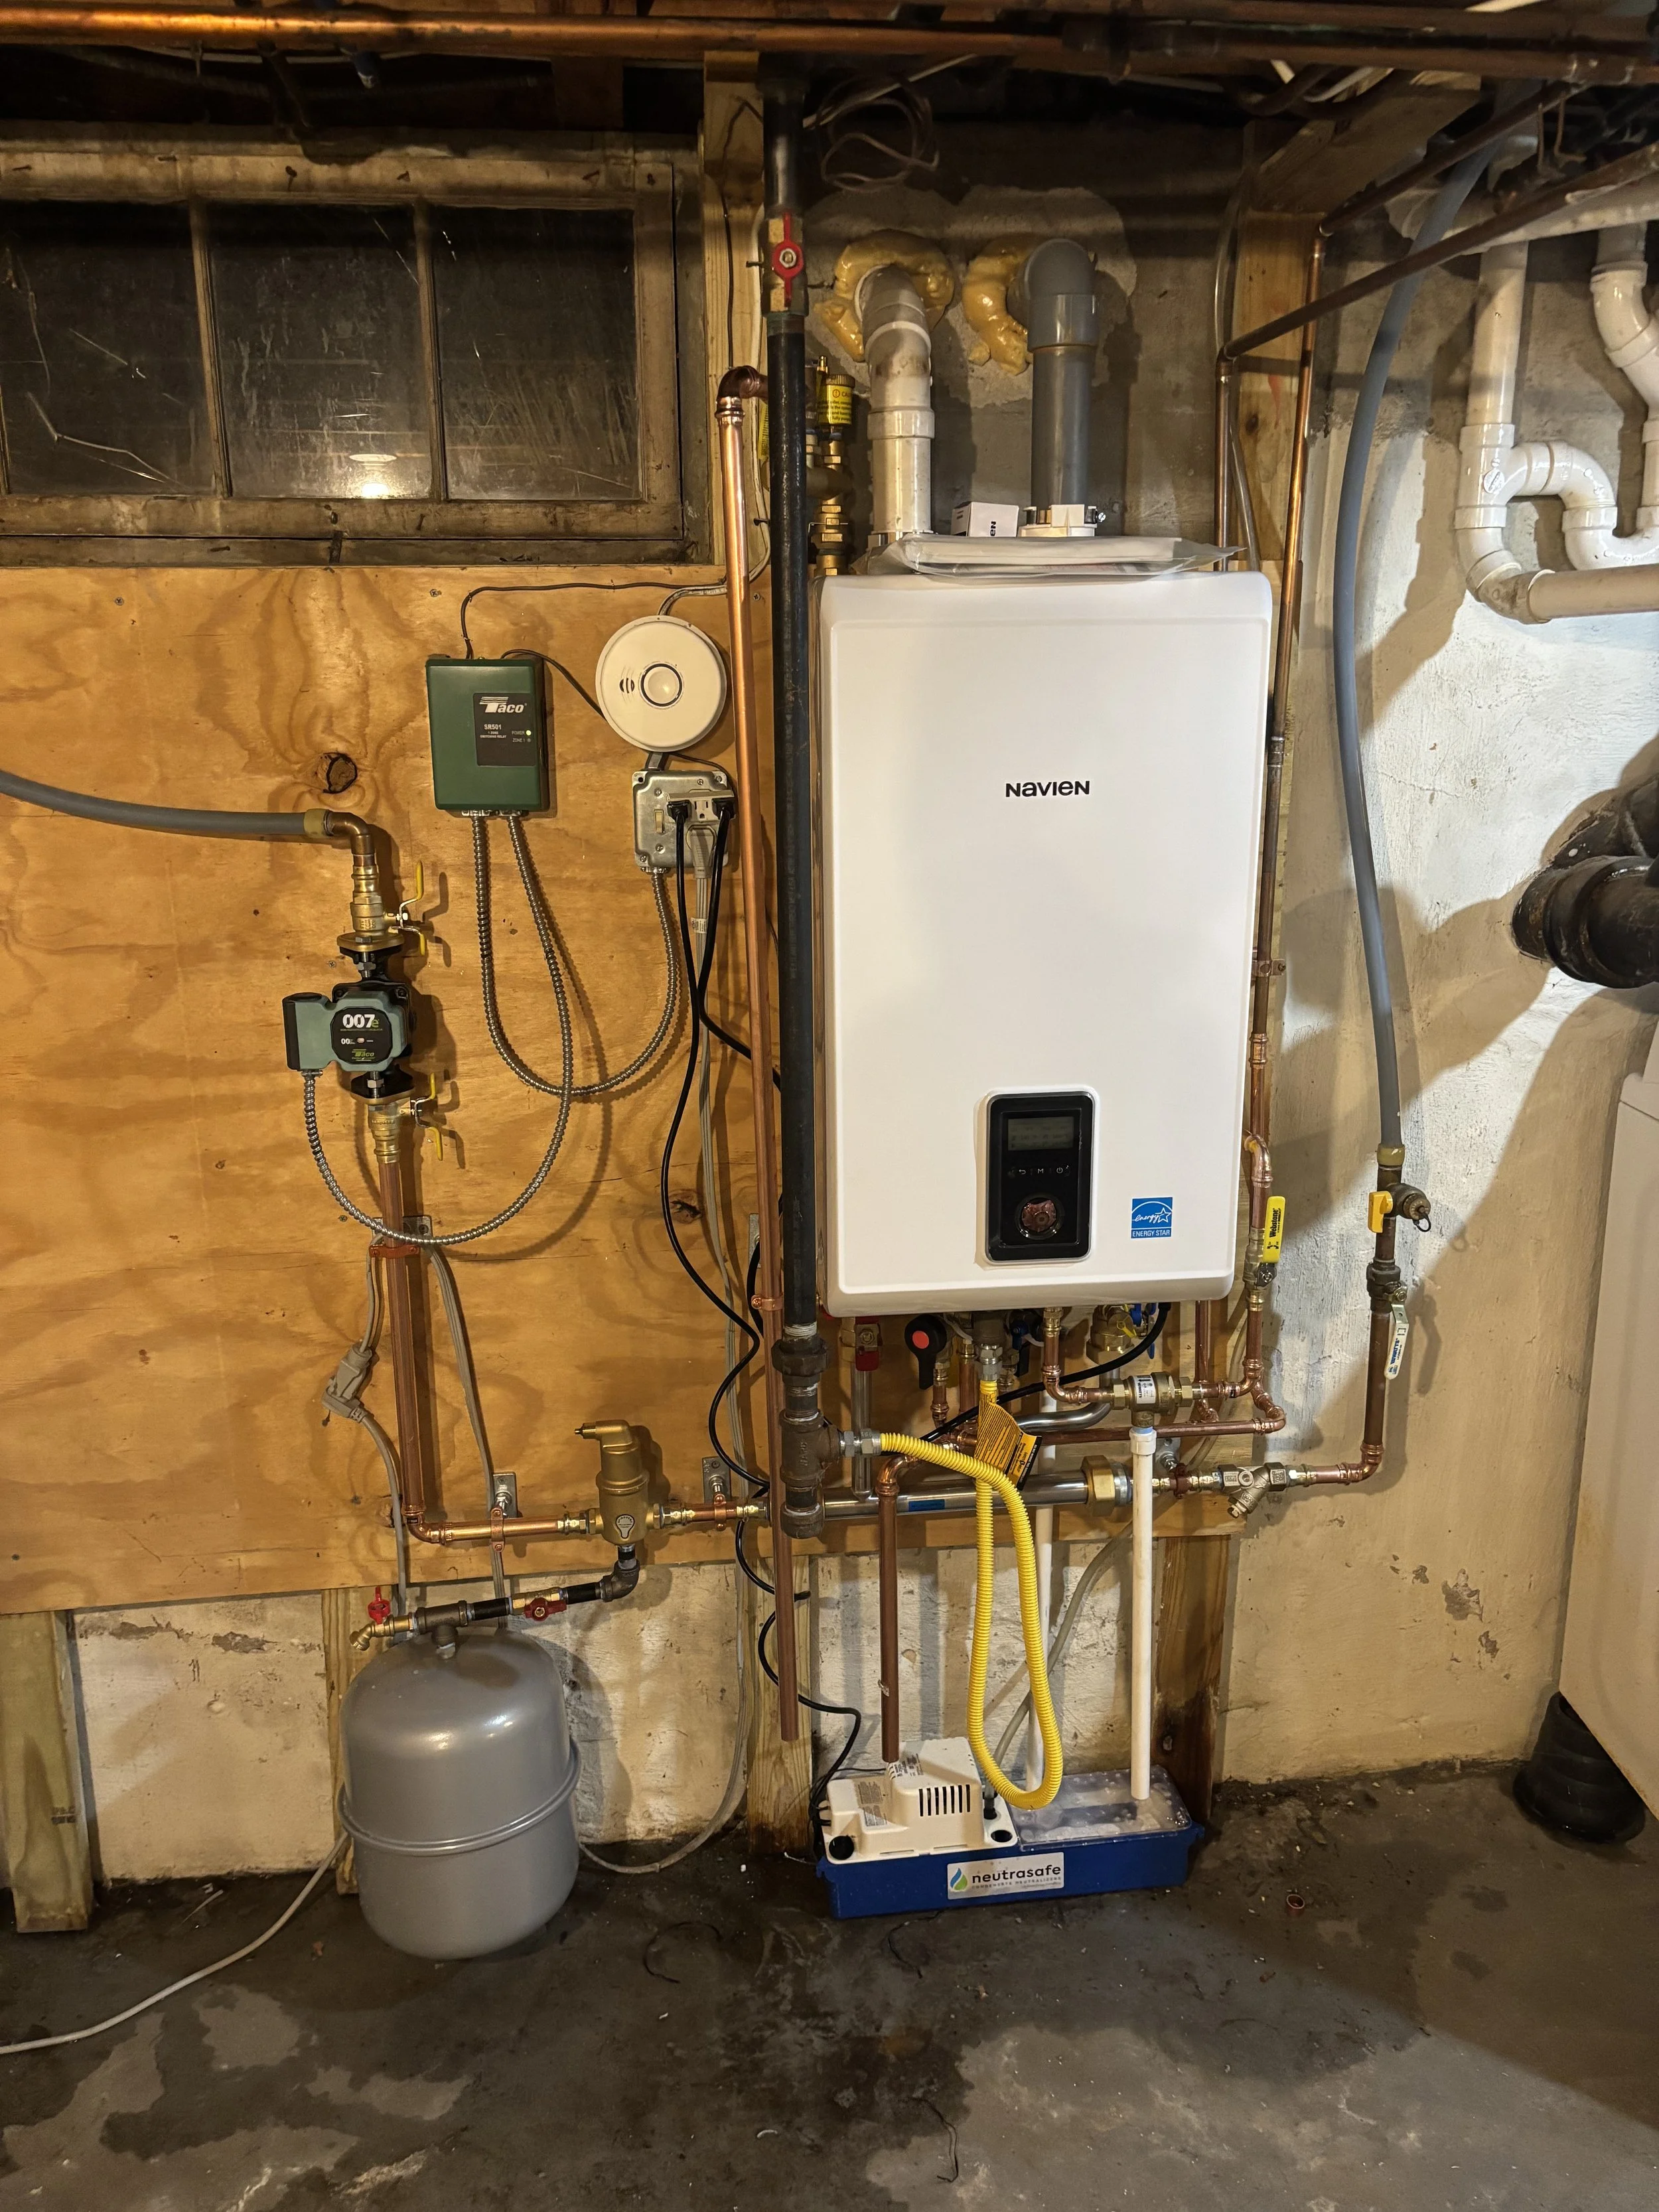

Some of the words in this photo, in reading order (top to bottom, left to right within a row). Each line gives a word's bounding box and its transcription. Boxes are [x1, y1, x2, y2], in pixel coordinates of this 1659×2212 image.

[479, 697, 524, 713] Taco
[1269, 1209, 1278, 1237] Webstone
[972, 1865, 1061, 1883] neutrasafe
